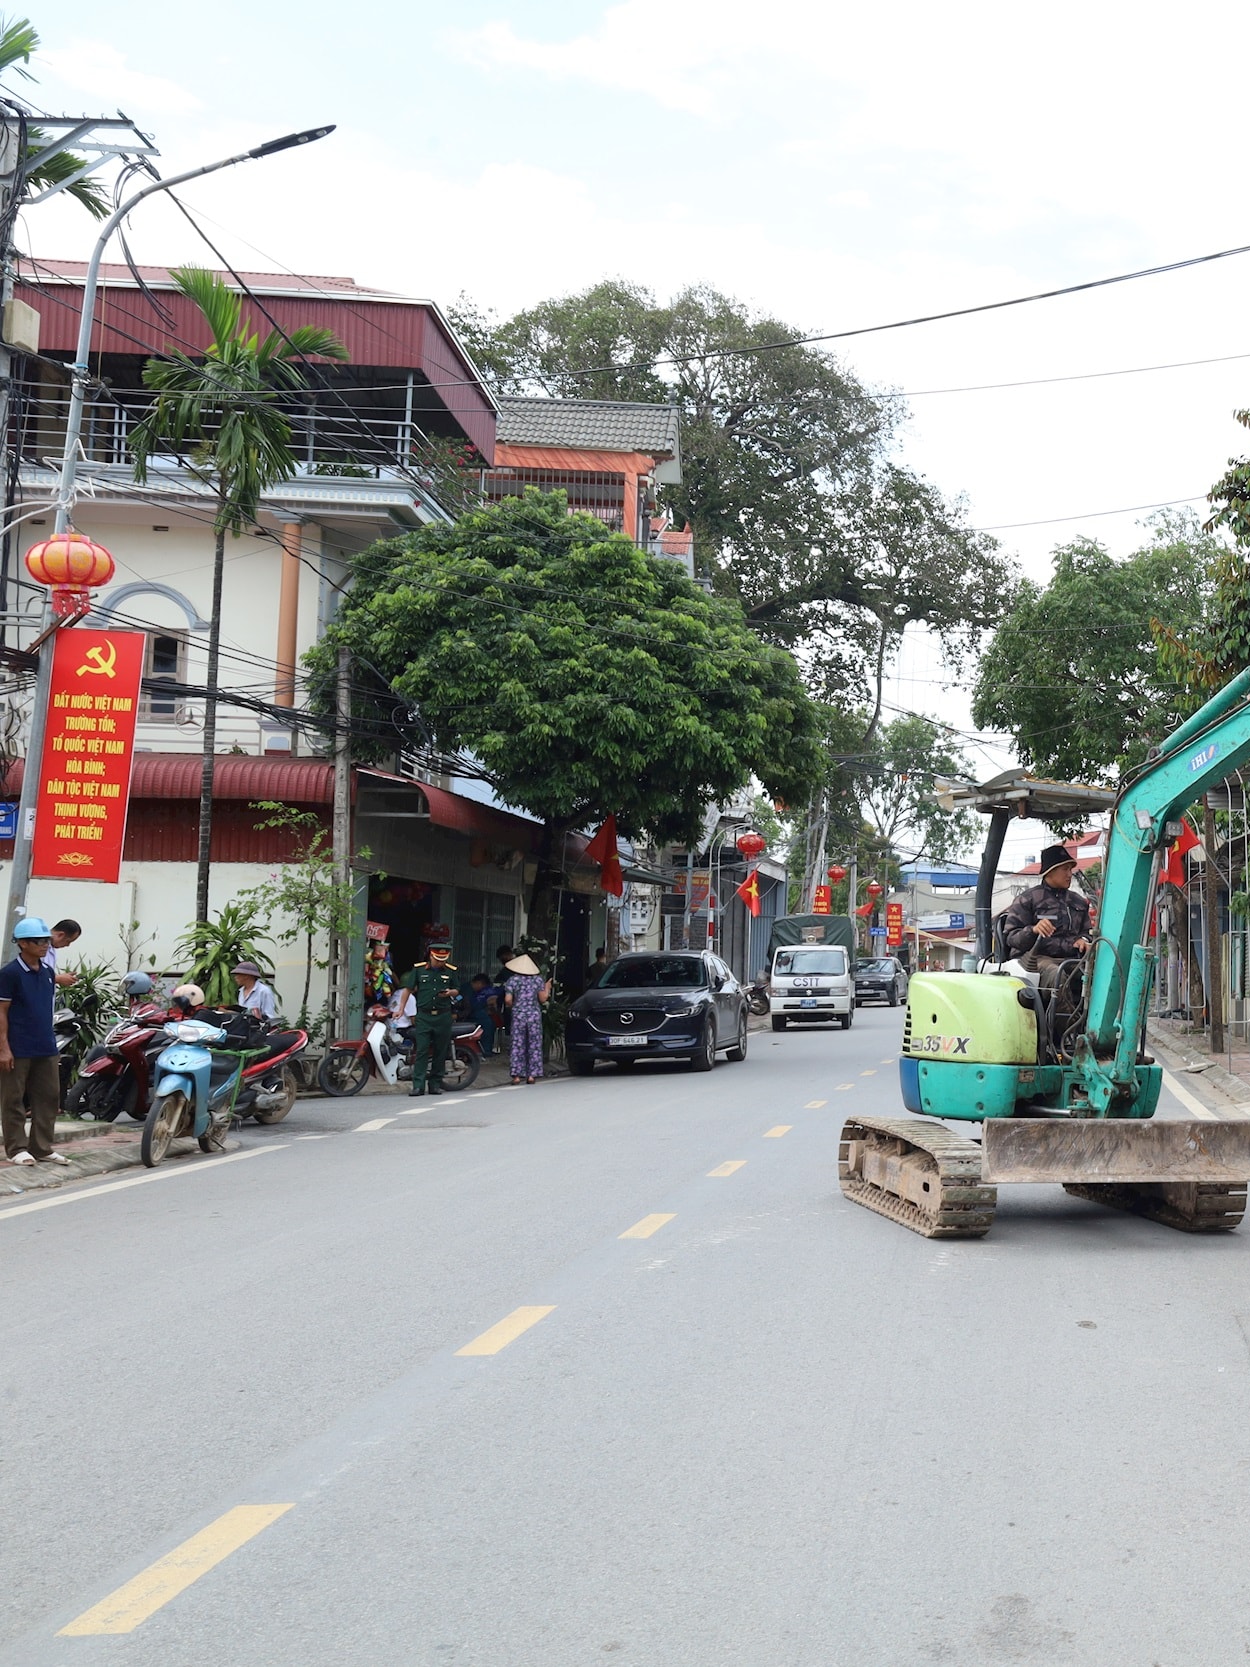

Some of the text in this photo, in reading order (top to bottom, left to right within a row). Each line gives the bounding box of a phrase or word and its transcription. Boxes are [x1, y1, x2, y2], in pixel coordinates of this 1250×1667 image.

[54, 690, 132, 713] ĐẤT NƯỚC VIỆT NAM
[65, 714, 97, 731] TRƯỜNG
[52, 732, 125, 756] TỔ QUỐC VIỆT NAM
[66, 757, 106, 776] HÒA BÌNH;
[47, 778, 120, 799] DÂN TỘC VIỆT NAM
[54, 802, 107, 821] THỊNH VƯỢNG,
[54, 821, 103, 840] PHÁT TRIỂN!
[792, 977, 820, 987] CSTT
[923, 1035, 970, 1054] 35VX
